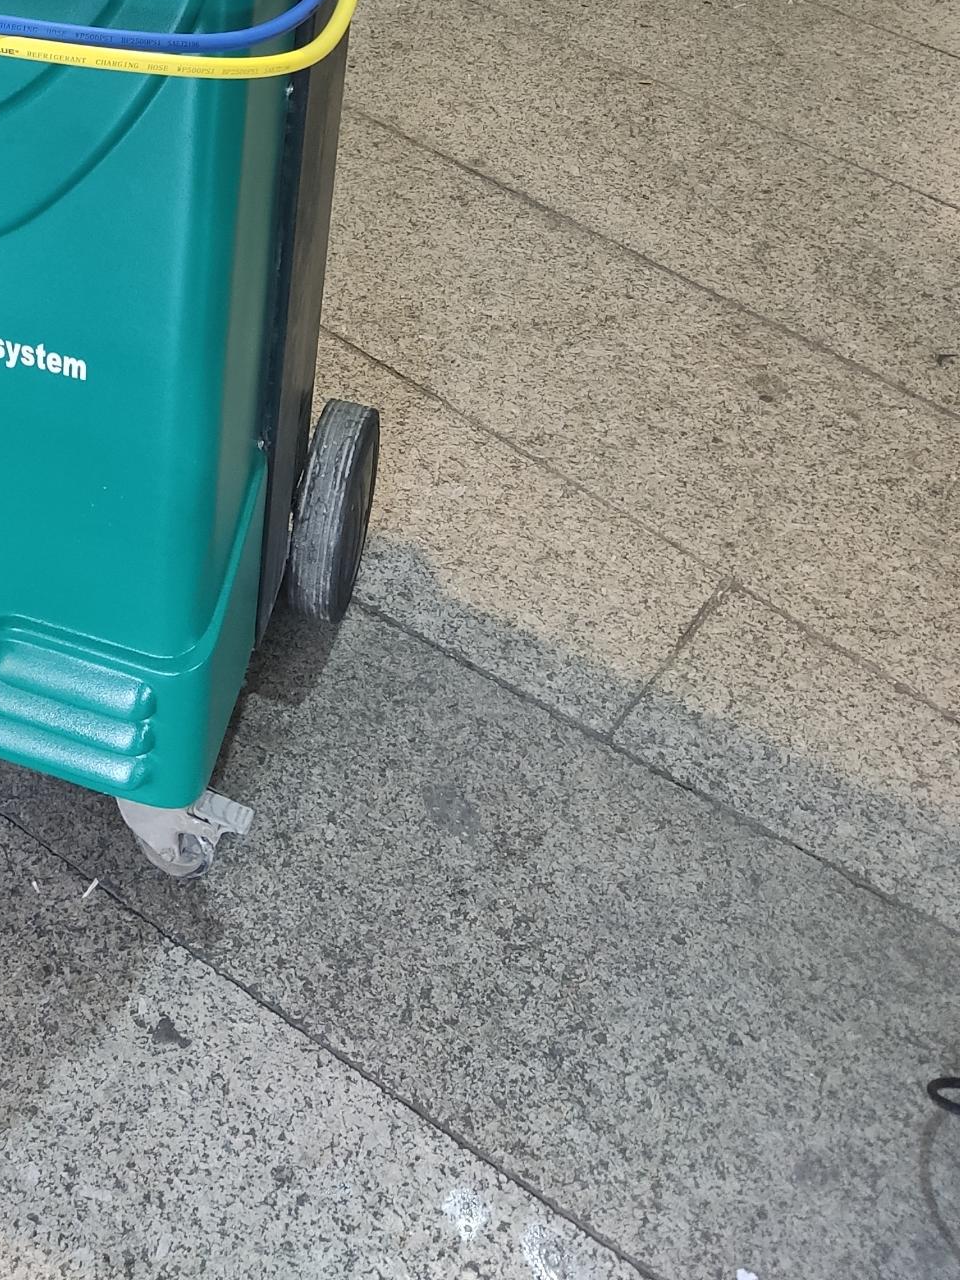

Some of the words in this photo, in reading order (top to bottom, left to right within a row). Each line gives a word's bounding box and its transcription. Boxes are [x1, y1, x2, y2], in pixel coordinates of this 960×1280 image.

[26, 50, 87, 64] REFRIGERANT
[95, 58, 139, 70] CHARGING
[147, 63, 169, 72] HOSE
